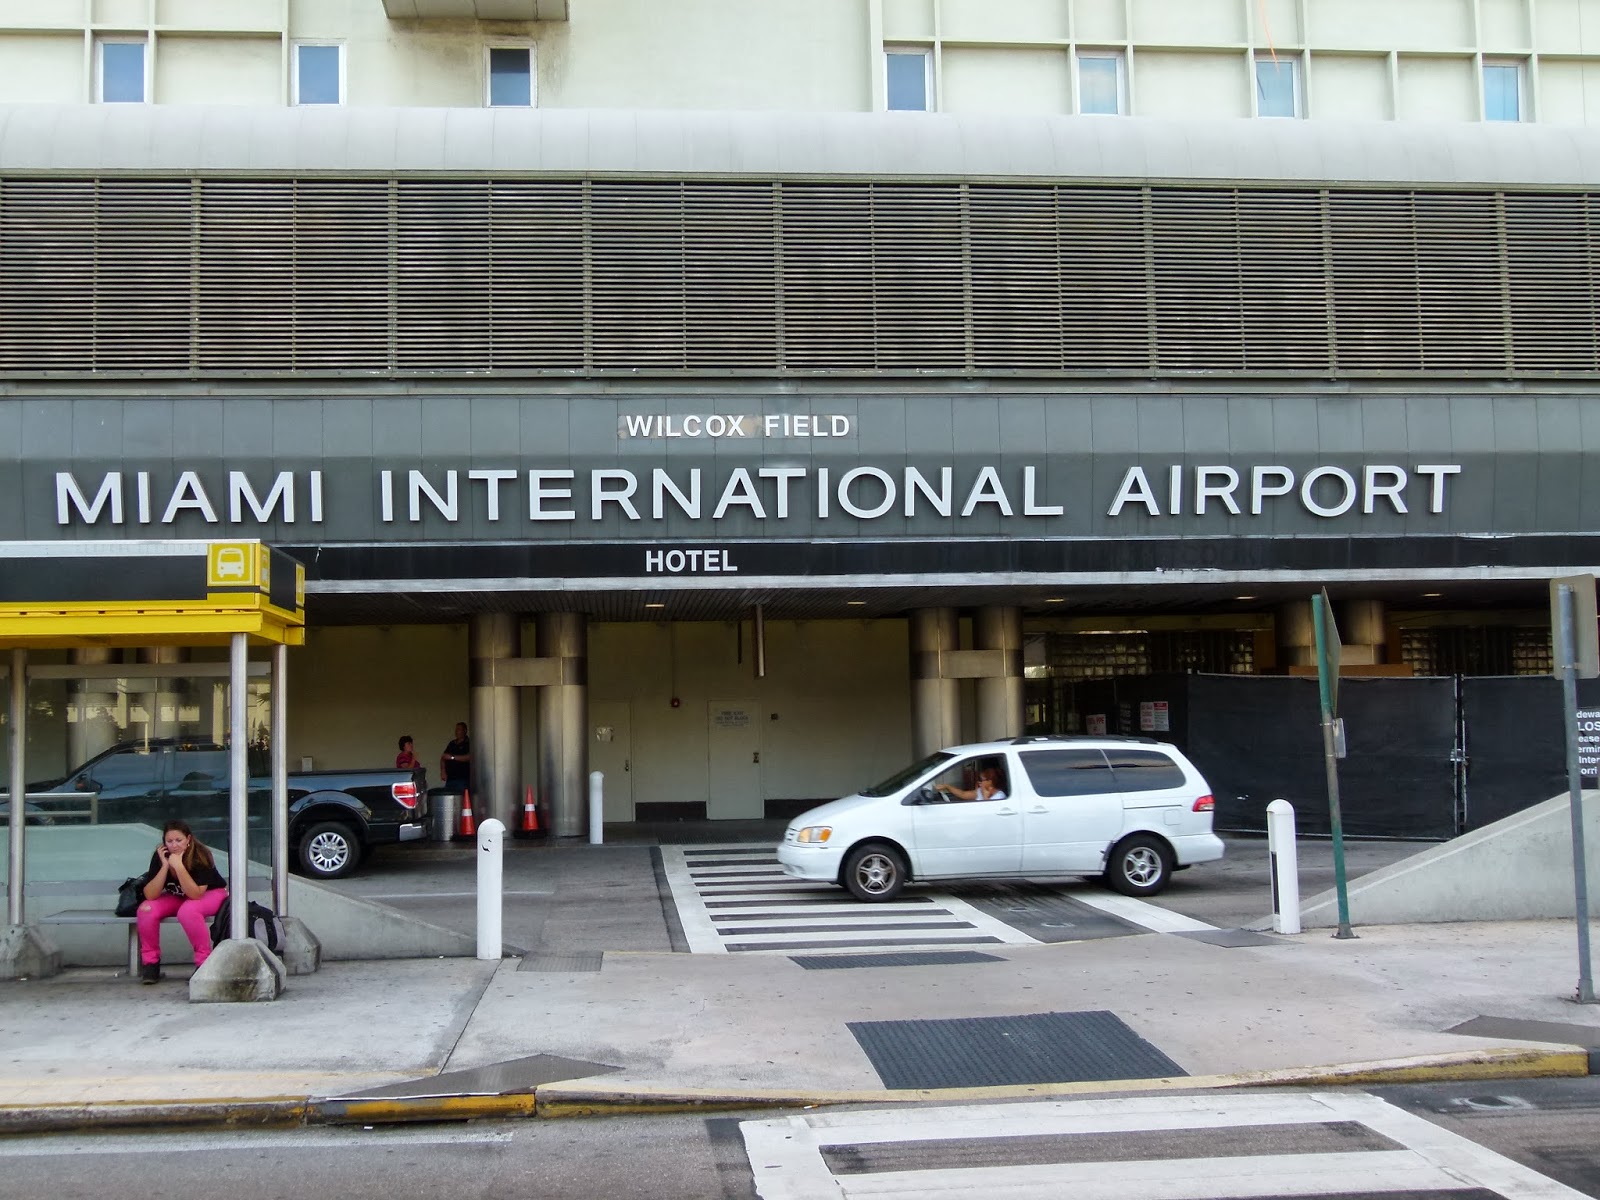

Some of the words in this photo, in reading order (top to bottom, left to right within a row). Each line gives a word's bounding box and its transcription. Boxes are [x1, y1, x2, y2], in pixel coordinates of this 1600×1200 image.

[626, 415, 746, 437] WILCOX
[764, 414, 850, 437] FIELD
[55, 470, 323, 524] MIAMI
[380, 465, 1064, 521] INTERNATIONAL
[1108, 464, 1462, 517] AIRPORT
[645, 549, 738, 573] HOTEL
